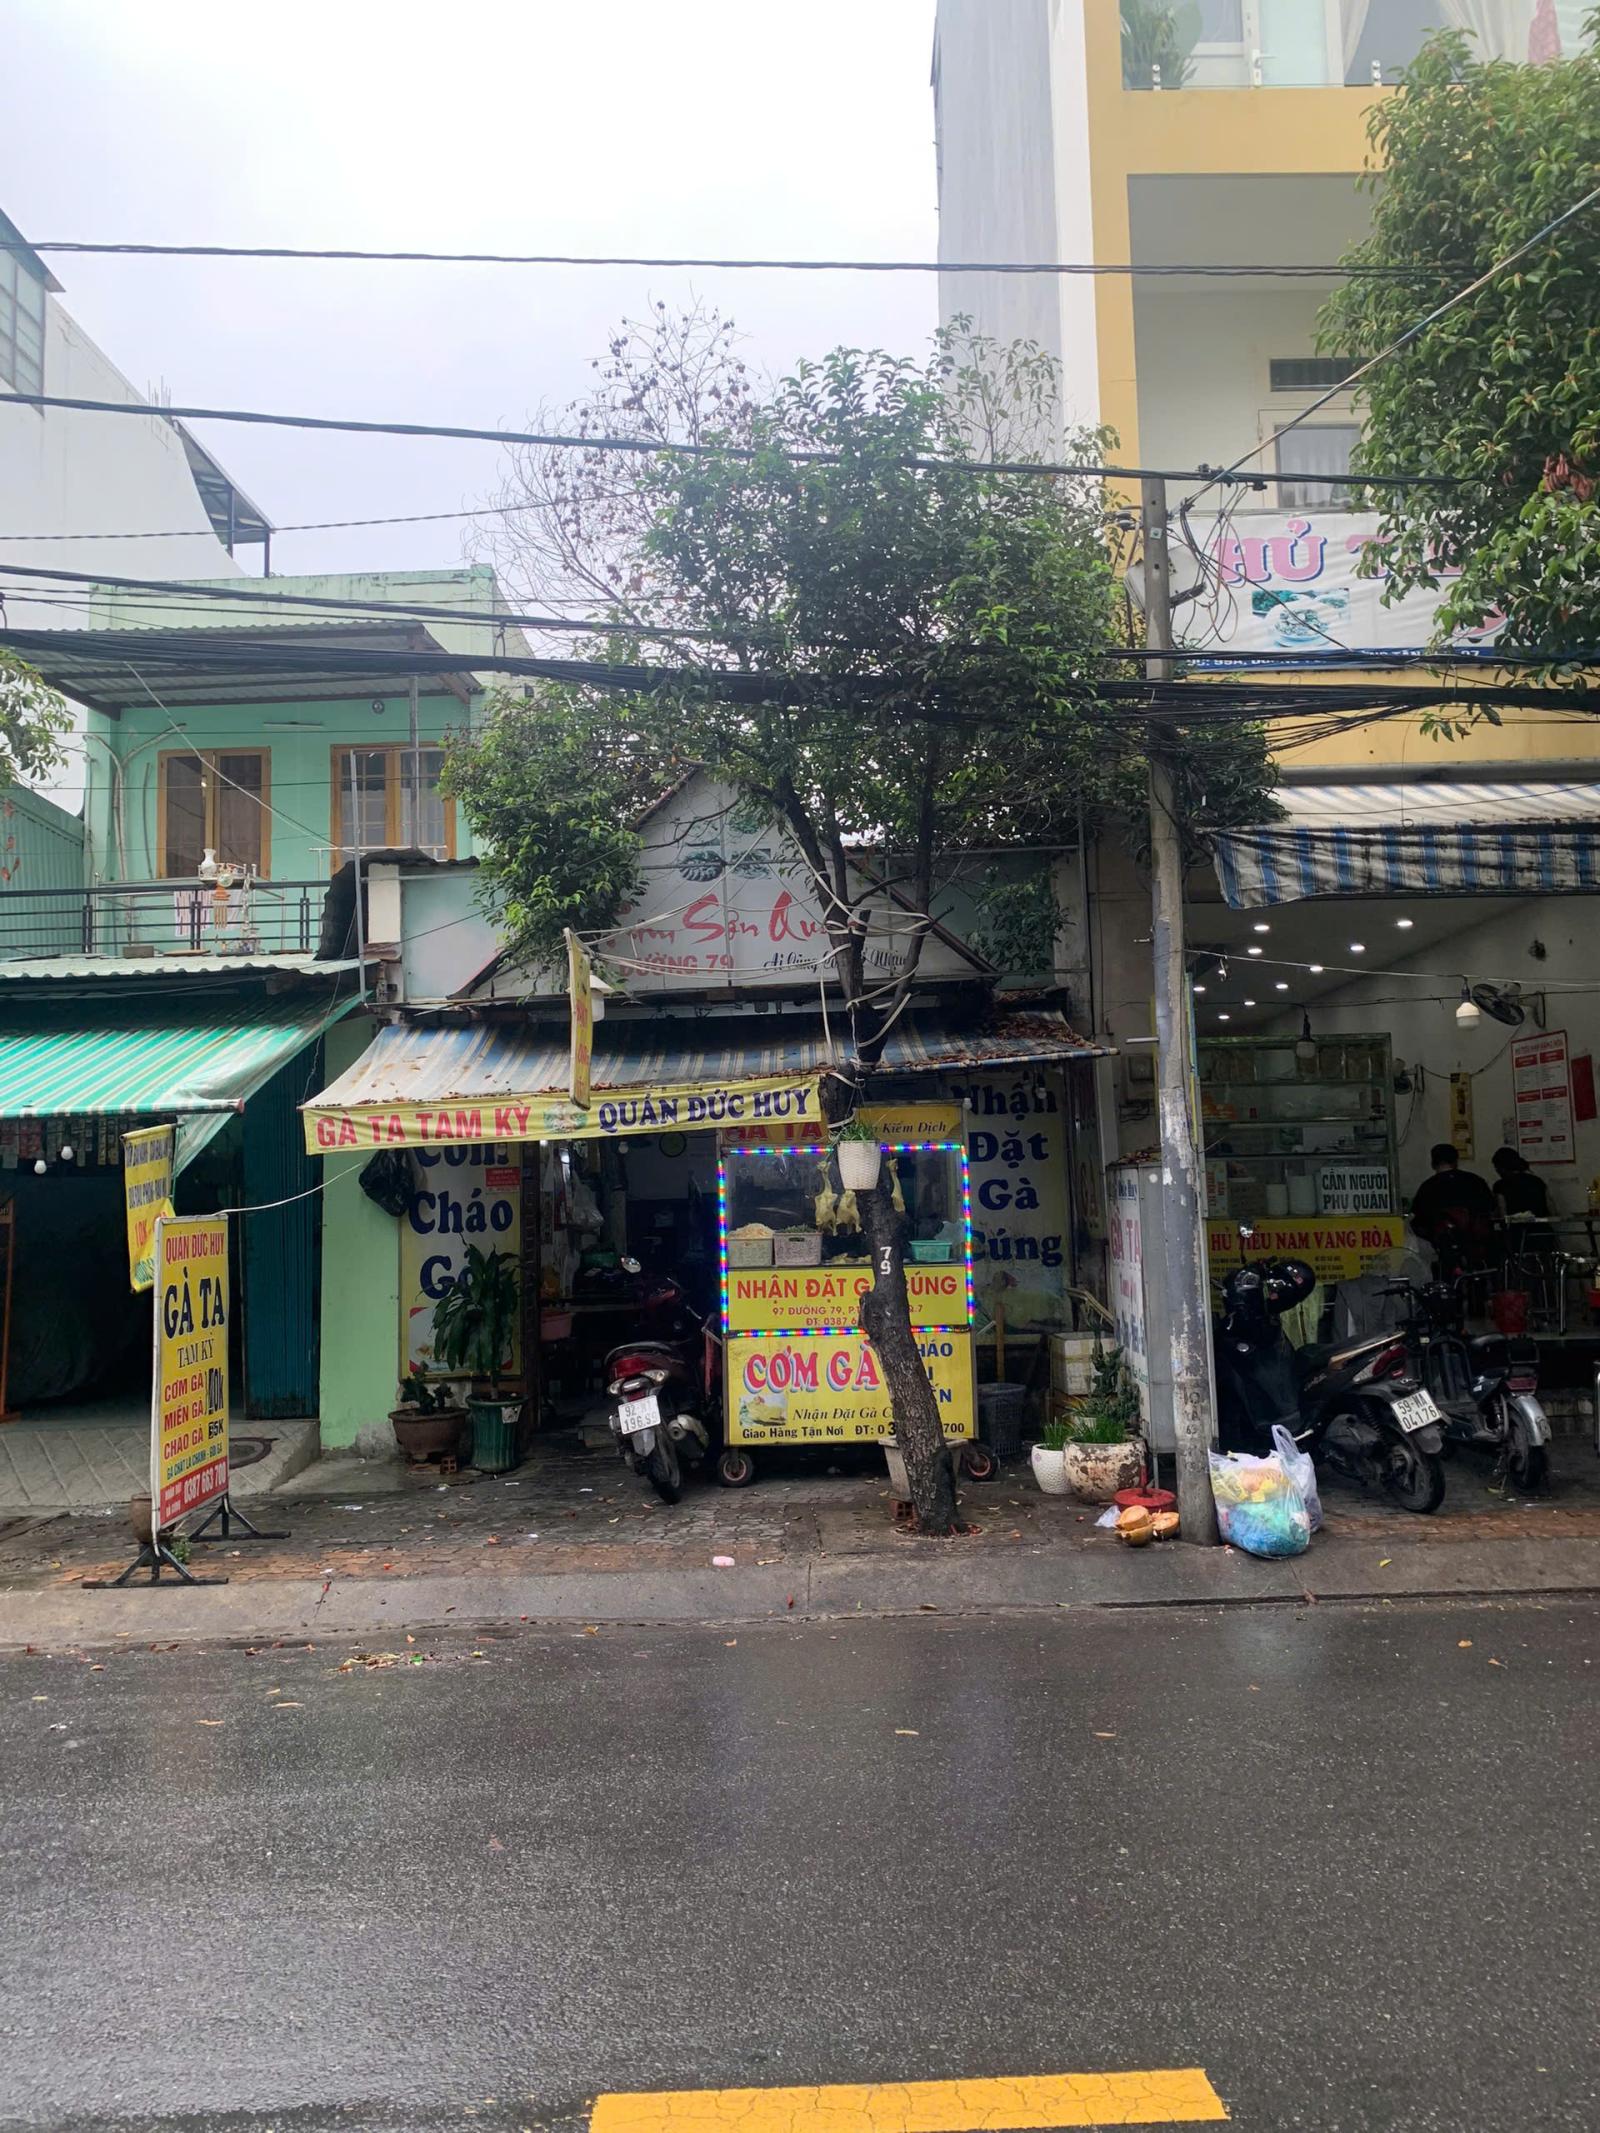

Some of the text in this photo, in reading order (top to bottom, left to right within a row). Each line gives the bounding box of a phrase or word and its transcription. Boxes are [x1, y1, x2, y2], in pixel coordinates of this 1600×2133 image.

[768, 890, 845, 942] Qu
[316, 1099, 532, 1147] GÀ TA TAM KỲ
[598, 1087, 811, 1133] QUÁN ĐỨC HUY
[967, 1130, 1049, 1169] Đặt
[409, 1187, 513, 1234] Cháo
[978, 1177, 1041, 1211] Gà
[209, 1232, 225, 1256] HUY
[970, 1228, 1063, 1268] Cúng
[1275, 1232, 1309, 1250] NAM
[1313, 1230, 1357, 1249] VANG
[1360, 1225, 1393, 1248] HÒA
[164, 1266, 225, 1339] GÀ TA
[737, 1270, 958, 1304] NHẬN ĐẶT G ÚNG
[772, 1306, 784, 1316] 97
[823, 1316, 848, 1326] 0387
[177, 1341, 199, 1369] TAM
[744, 1338, 953, 1392] CƠM GÀ HÁO
[792, 1408, 828, 1421] Nhận
[832, 1407, 856, 1421] Đặt
[860, 1407, 878, 1419] Gà
[1402, 1405, 1437, 1430] 04176
[742, 1427, 766, 1439] Giao
[769, 1426, 798, 1440] Hàng
[801, 1425, 823, 1438] Tận
[855, 1424, 874, 1436] ĐT:
